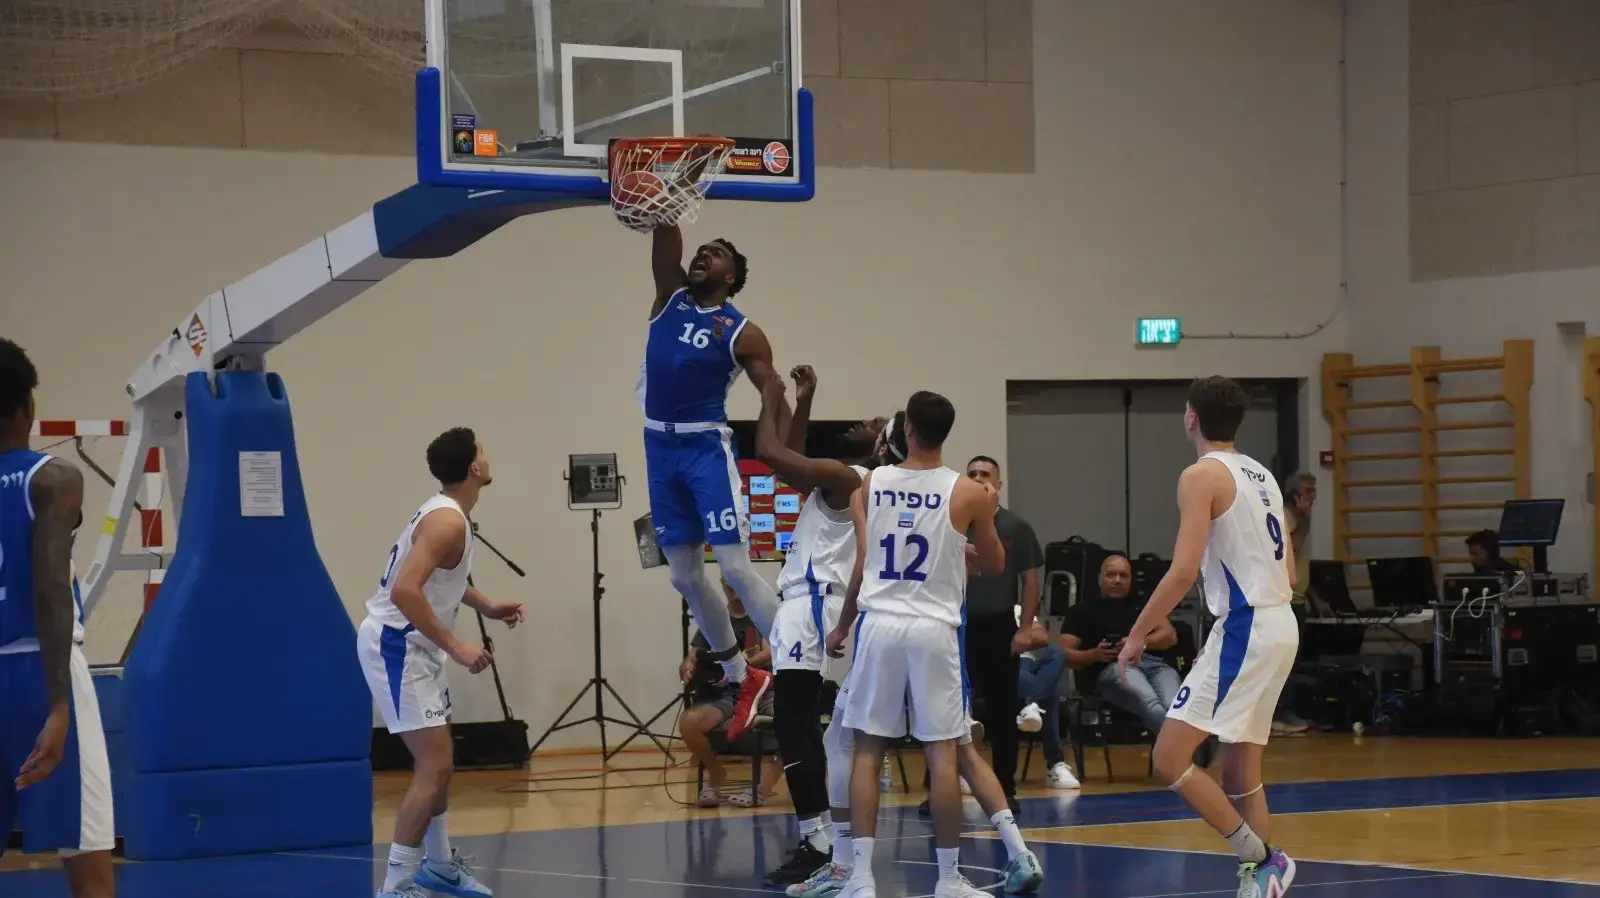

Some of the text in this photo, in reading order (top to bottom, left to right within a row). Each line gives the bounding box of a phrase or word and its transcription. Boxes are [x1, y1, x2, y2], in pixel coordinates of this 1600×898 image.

[478, 133, 494, 145] FIBA
[678, 322, 712, 349] 16
[1141, 319, 1176, 343] יציאה
[874, 490, 942, 510] טפירו
[706, 507, 737, 532] 16
[1266, 512, 1284, 561] 9
[879, 533, 929, 582] 12
[789, 640, 803, 663] 4
[1172, 685, 1190, 709] 9
